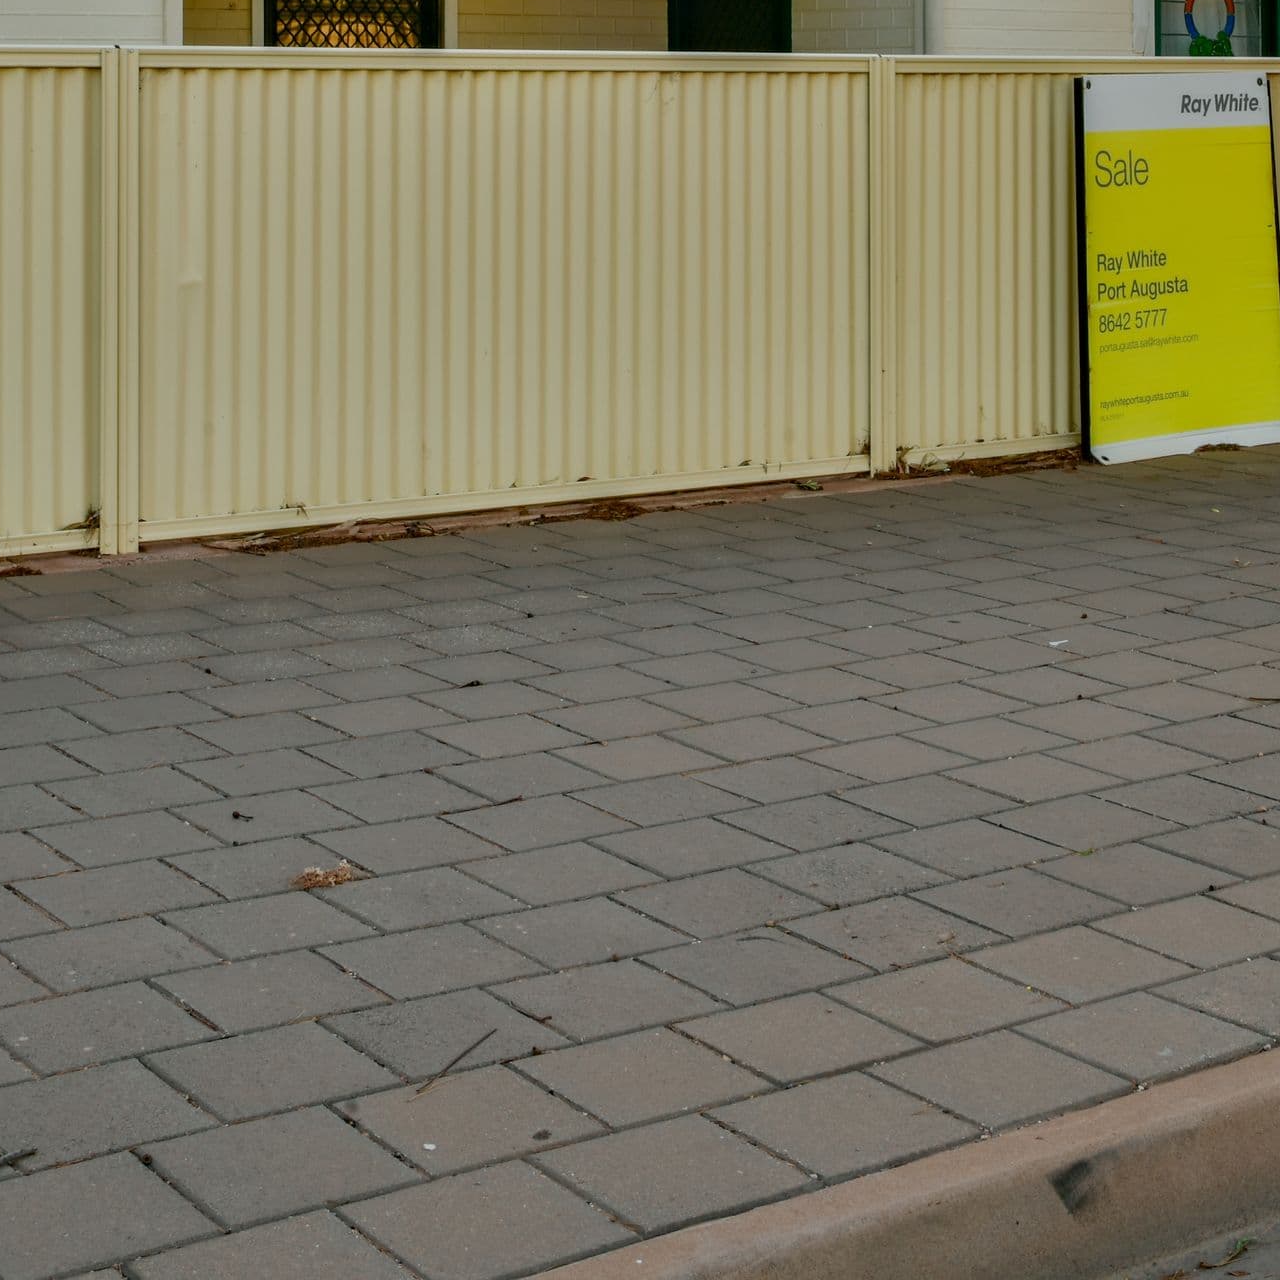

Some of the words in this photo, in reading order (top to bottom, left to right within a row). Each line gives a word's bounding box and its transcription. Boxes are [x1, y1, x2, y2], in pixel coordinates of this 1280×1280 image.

[1181, 94, 1211, 116] Ray
[1215, 93, 1259, 112] White
[1095, 150, 1149, 188] Sale
[1097, 253, 1122, 275] Ray
[1127, 249, 1167, 269] White
[1098, 282, 1126, 301] Port
[1130, 277, 1189, 300] Augusta
[1099, 312, 1131, 333] 8642
[1135, 308, 1167, 329] 5777
